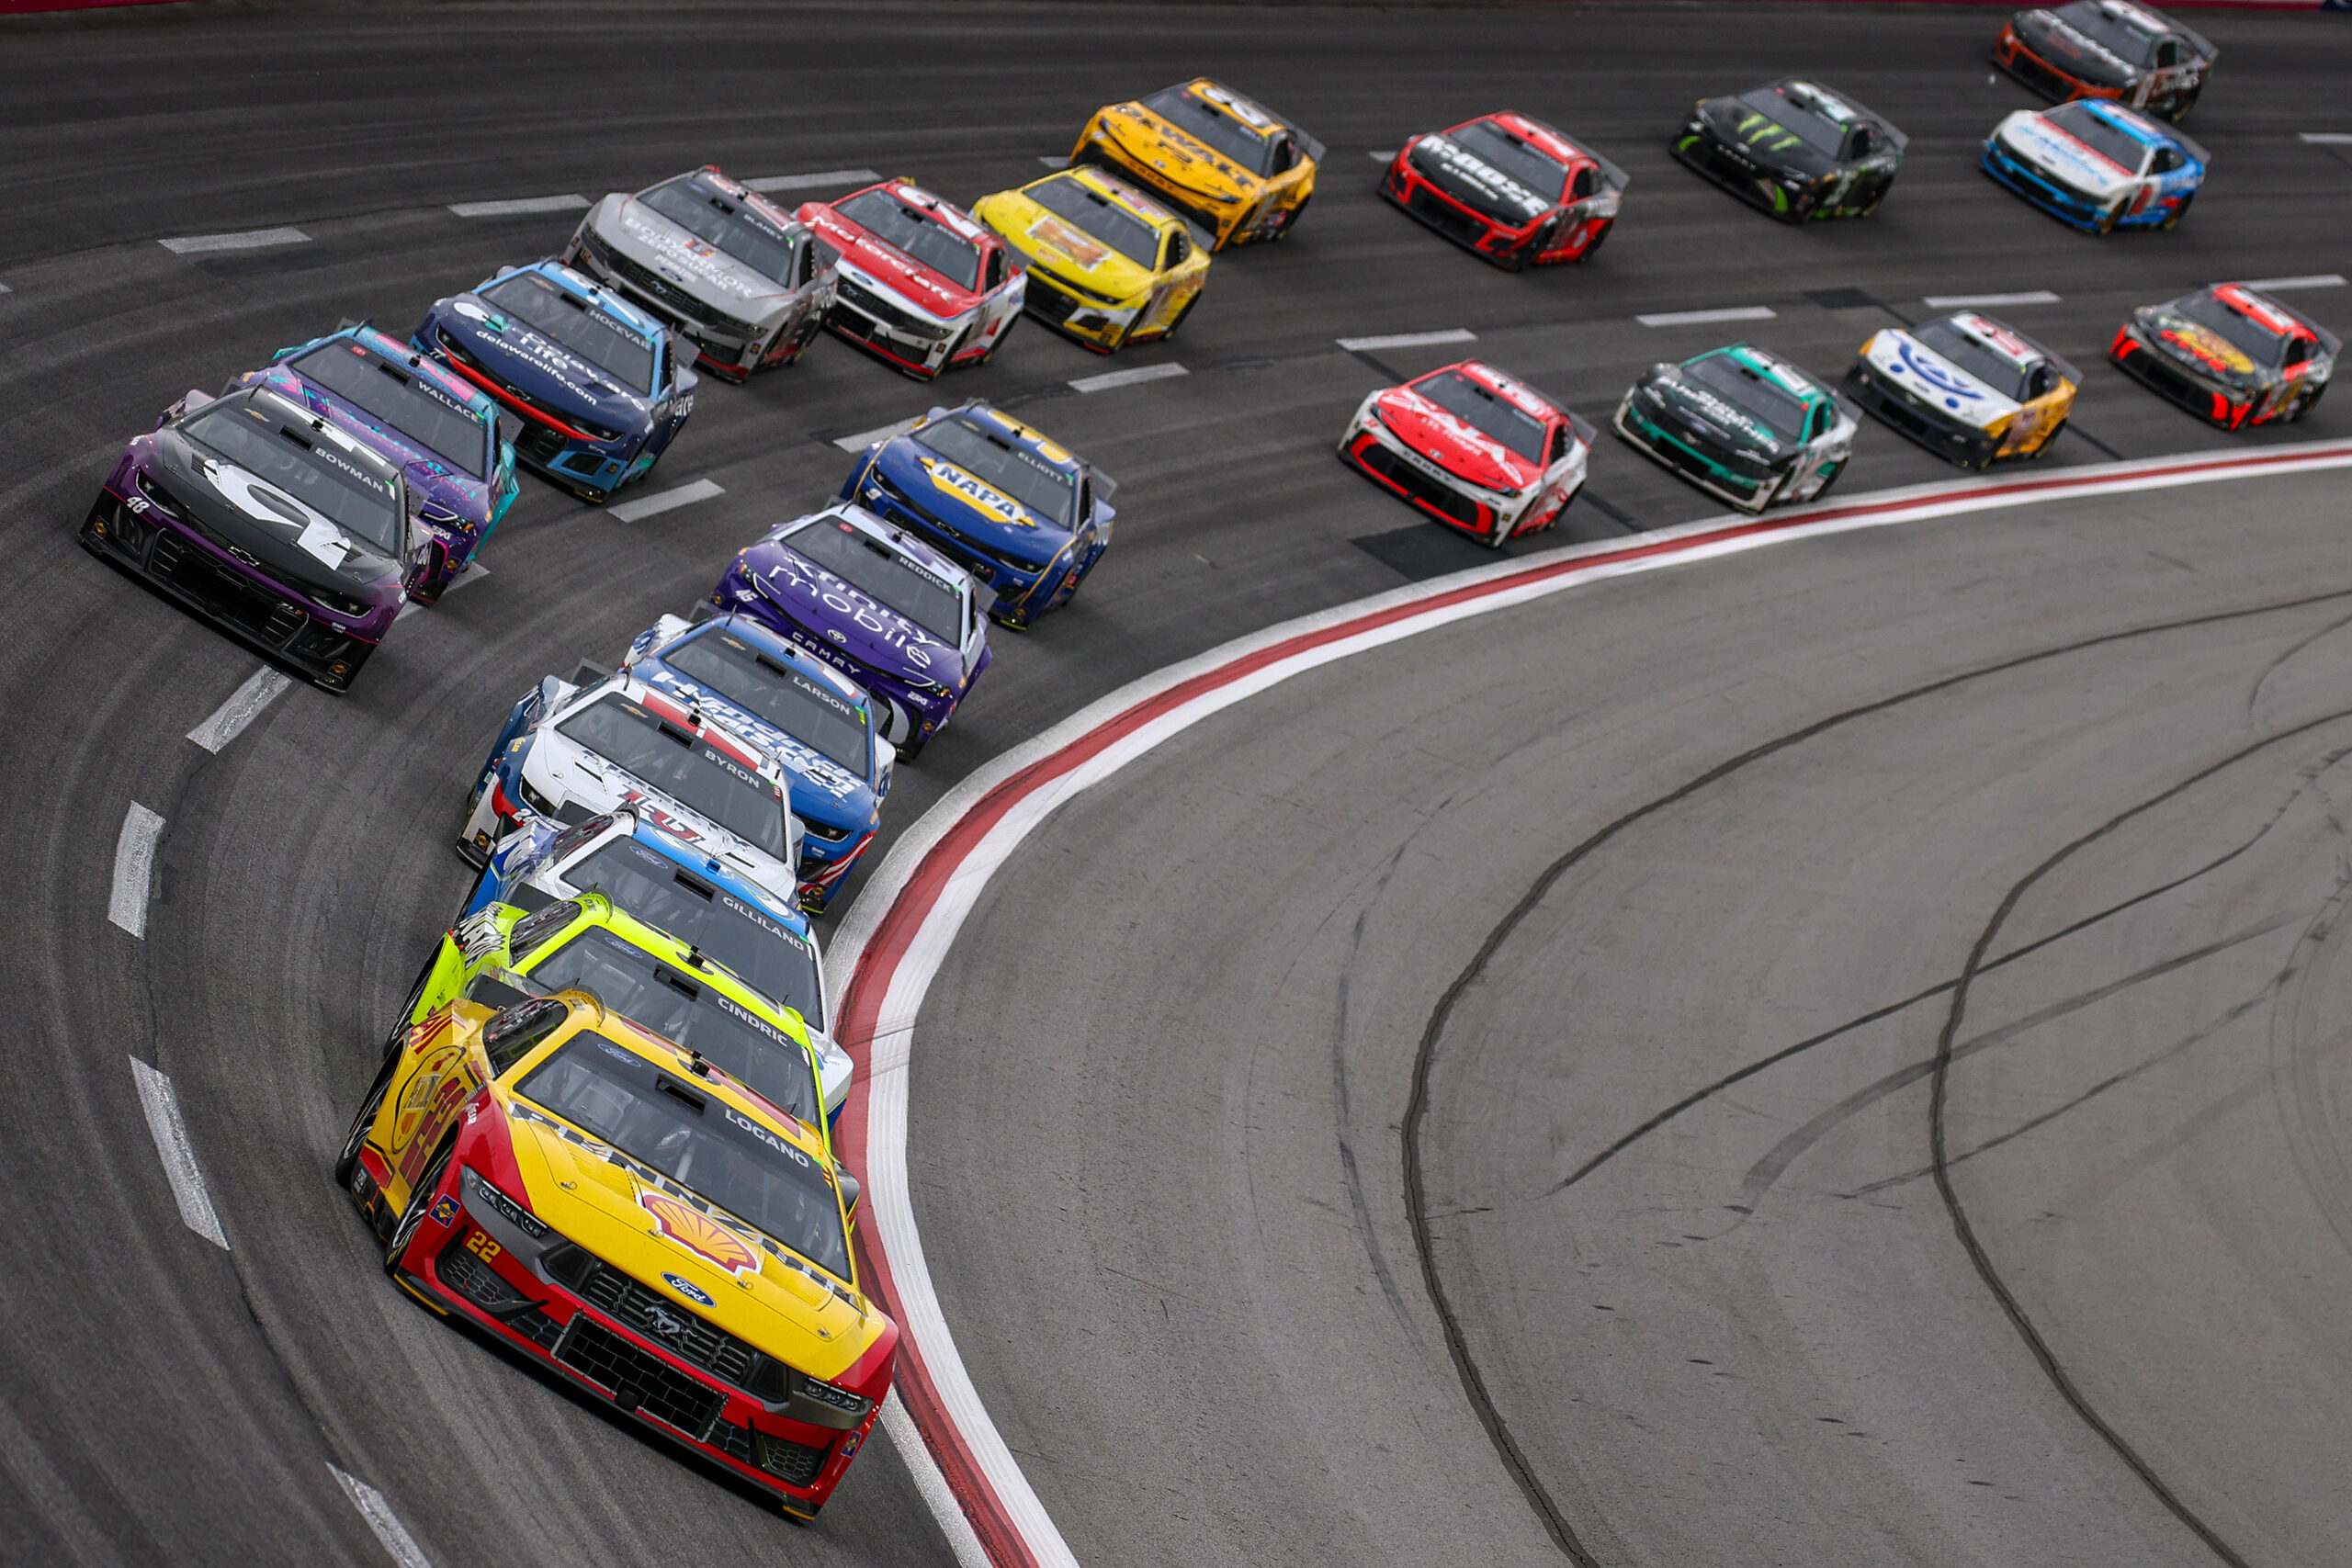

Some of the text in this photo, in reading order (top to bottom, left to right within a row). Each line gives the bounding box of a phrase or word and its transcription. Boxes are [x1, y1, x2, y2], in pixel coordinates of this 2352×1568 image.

[743, 213, 784, 241] BLANEY
[624, 217, 754, 298] BODYARMOR
[638, 233, 679, 262] ZERO
[677, 254, 730, 291] SUGAR
[589, 309, 650, 350] HOCEVAR
[475, 330, 597, 407] delawarelife.com
[519, 335, 571, 371] Life
[525, 332, 646, 412] Delaware
[417, 380, 480, 423] WALLACE
[314, 446, 384, 493] BOWMAN
[1017, 451, 1065, 482] ELLIOTT
[126, 496, 151, 514] 48
[937, 465, 1017, 518] NAPA
[899, 556, 952, 592] REDDICK
[734, 588, 759, 603] 45
[768, 564, 932, 670] mobile
[791, 631, 861, 675] CAMRY
[793, 675, 852, 716] LARSON
[704, 749, 761, 790] BYRON
[721, 896, 805, 953] GILLILAND
[717, 997, 789, 1049] CINDRIC
[600, 1043, 639, 1066] Ford
[724, 1107, 810, 1168] LOGANO
[465, 1230, 502, 1264] 22
[668, 1275, 708, 1305] Ford
